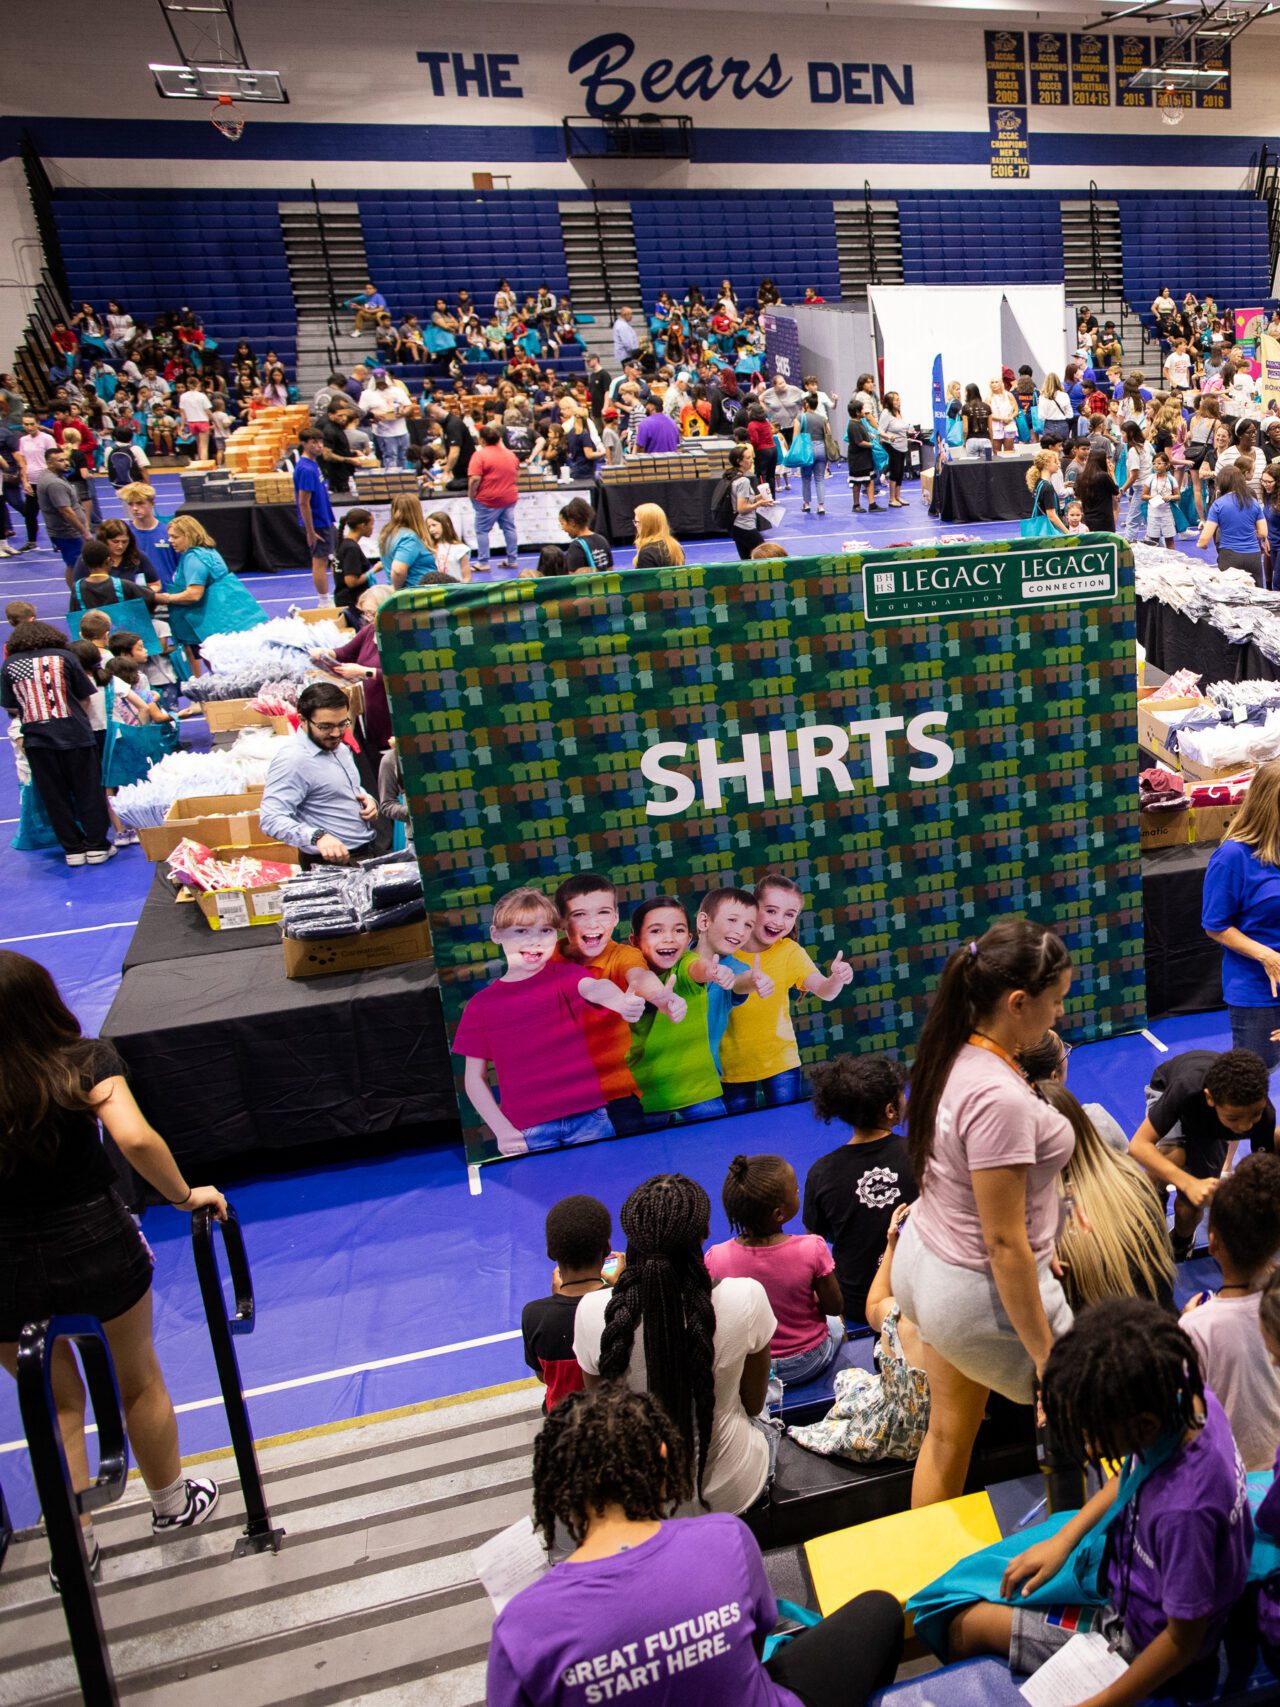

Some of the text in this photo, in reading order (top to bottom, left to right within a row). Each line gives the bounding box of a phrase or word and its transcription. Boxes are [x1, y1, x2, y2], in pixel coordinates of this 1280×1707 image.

[416, 32, 915, 118] THE Bears DEN
[996, 92, 1018, 103] 2009
[1039, 92, 1061, 104] 2013
[1074, 92, 1109, 105] 2014-15
[1123, 93, 1145, 105] 2015
[1203, 95, 1224, 106] 2016
[991, 141, 1027, 149] CHAMPIONS
[991, 165, 1029, 177] 2016-17
[1021, 552, 1110, 579] LEGACY
[875, 574, 893, 583] BH
[902, 562, 1007, 593] LEGACY
[875, 583, 893, 592] HS
[1028, 578, 1105, 593] CONNECTION
[875, 594, 1004, 612] FOUNDATION
[640, 711, 955, 817] SHIRTS
[561, 1601, 741, 1687] GREAT FUTURES
[585, 1632, 731, 1704] START HERE.
